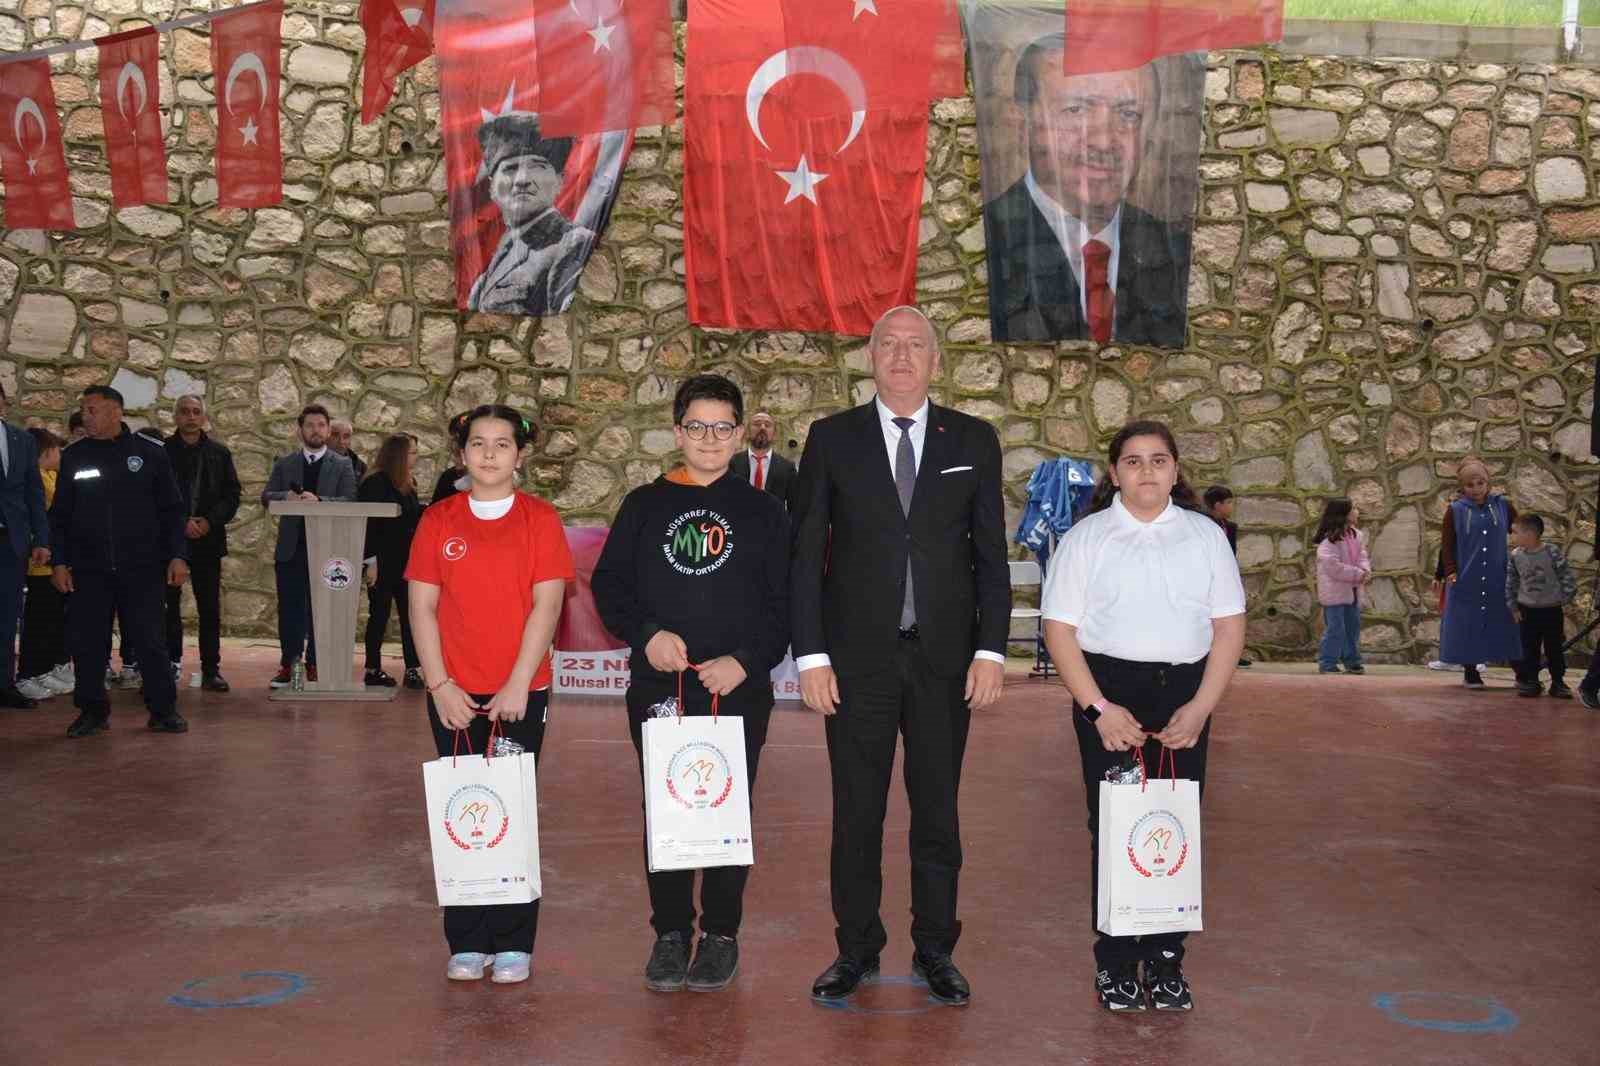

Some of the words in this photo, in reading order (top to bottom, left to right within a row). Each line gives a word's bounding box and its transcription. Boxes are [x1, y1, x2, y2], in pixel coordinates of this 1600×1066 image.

[665, 509, 707, 537] MÜŞERREF
[708, 510, 733, 536] YILMAZ
[673, 560, 694, 575] HATİP
[695, 542, 734, 576] ORTAOKULU
[562, 657, 594, 671] 23
[559, 675, 610, 689] Ulusal
